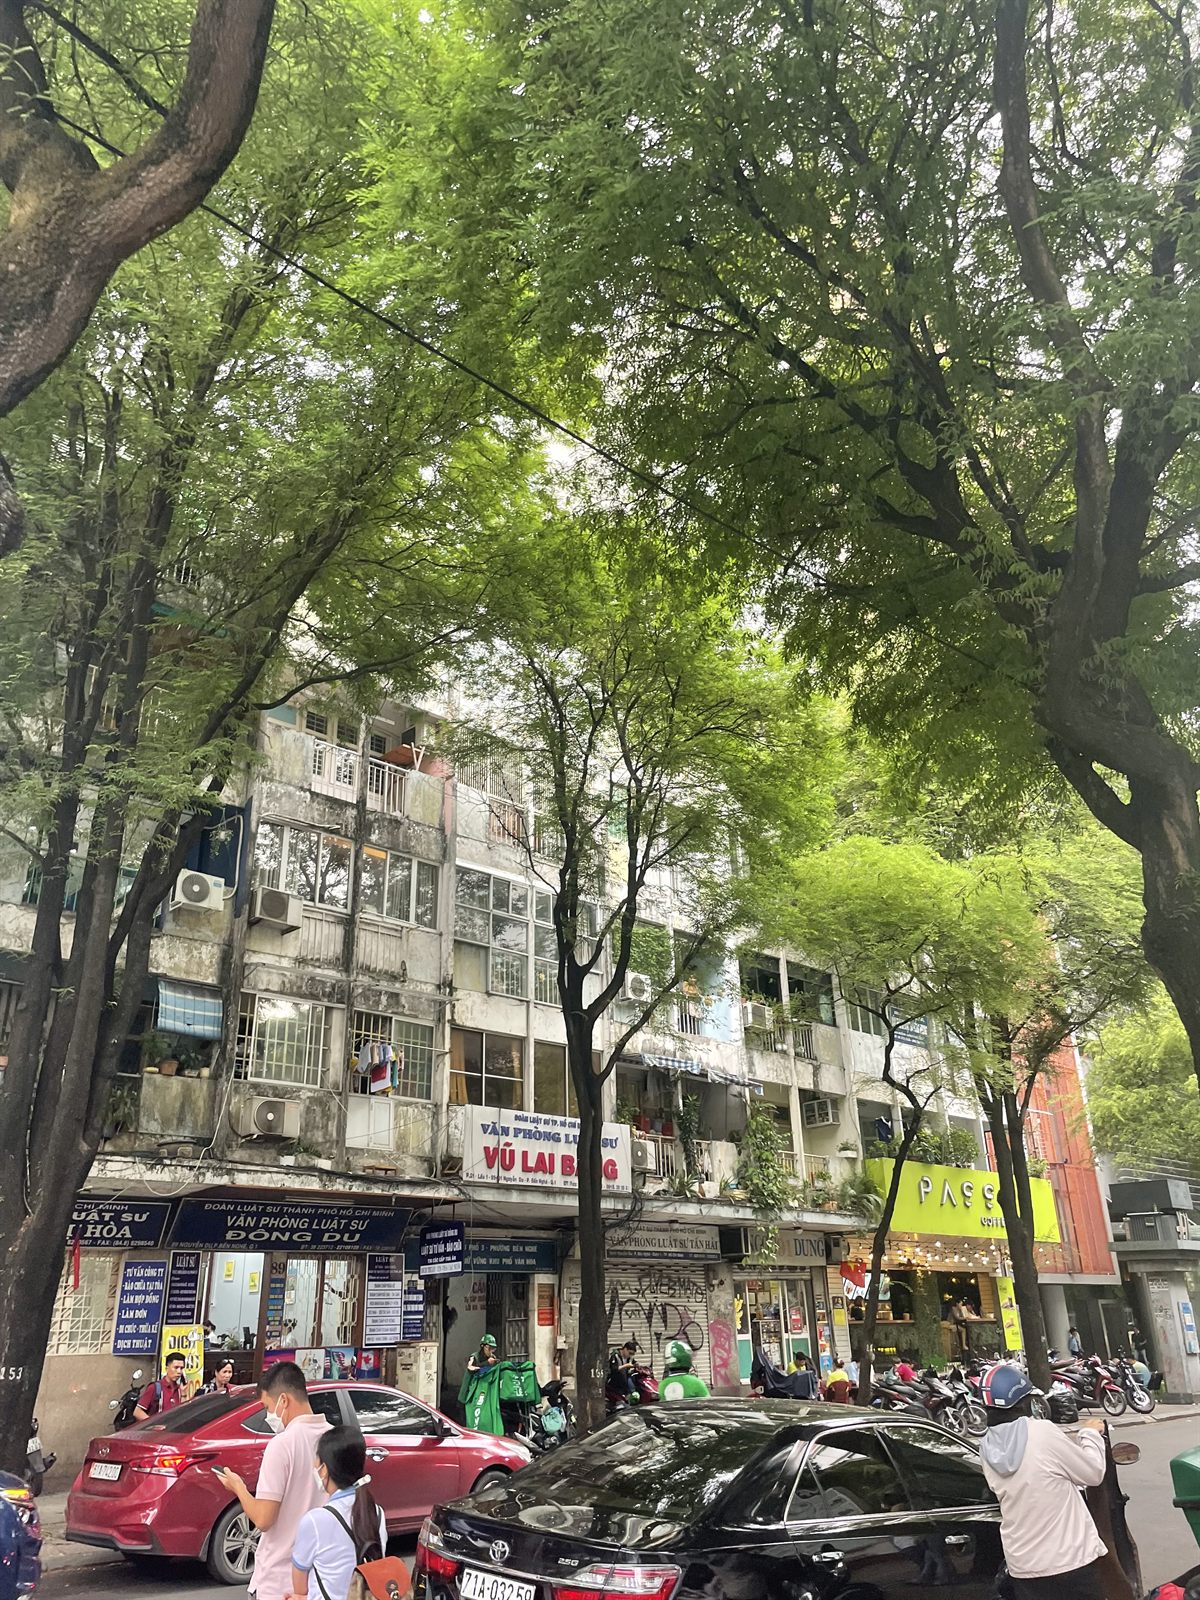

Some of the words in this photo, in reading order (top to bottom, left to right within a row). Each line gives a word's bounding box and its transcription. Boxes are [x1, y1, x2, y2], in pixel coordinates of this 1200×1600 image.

[480, 1121, 510, 1137] VĂN
[513, 1126, 562, 1143] PHÒNG
[564, 1133, 580, 1145] LU
[601, 1137, 619, 1149] SƯ
[483, 1141, 516, 1172] VŨ
[521, 1150, 555, 1175] LAI
[561, 1154, 618, 1180] BG
[919, 1174, 995, 1211] PASS
[204, 1202, 234, 1211] ĐOÀN
[237, 1204, 264, 1213] LUẬT
[282, 1206, 315, 1215] THÀNH
[120, 1211, 150, 1222] SƯ
[226, 1213, 257, 1228] VĂN
[259, 1214, 309, 1229] PHÒNG
[312, 1217, 348, 1232] LUẬT
[349, 1219, 370, 1231] SƯ
[83, 1221, 132, 1238] HÒA
[225, 1228, 313, 1242] ĐÔNG
[322, 1233, 361, 1243] DU
[179, 1240, 204, 1249] NGUYỄN
[679, 1237, 690, 1249] SƯ
[794, 1237, 825, 1258] DUNG
[271, 1261, 286, 1275] 89
[123, 1293, 134, 1304] LÀM
[121, 1307, 134, 1319] LÀM
